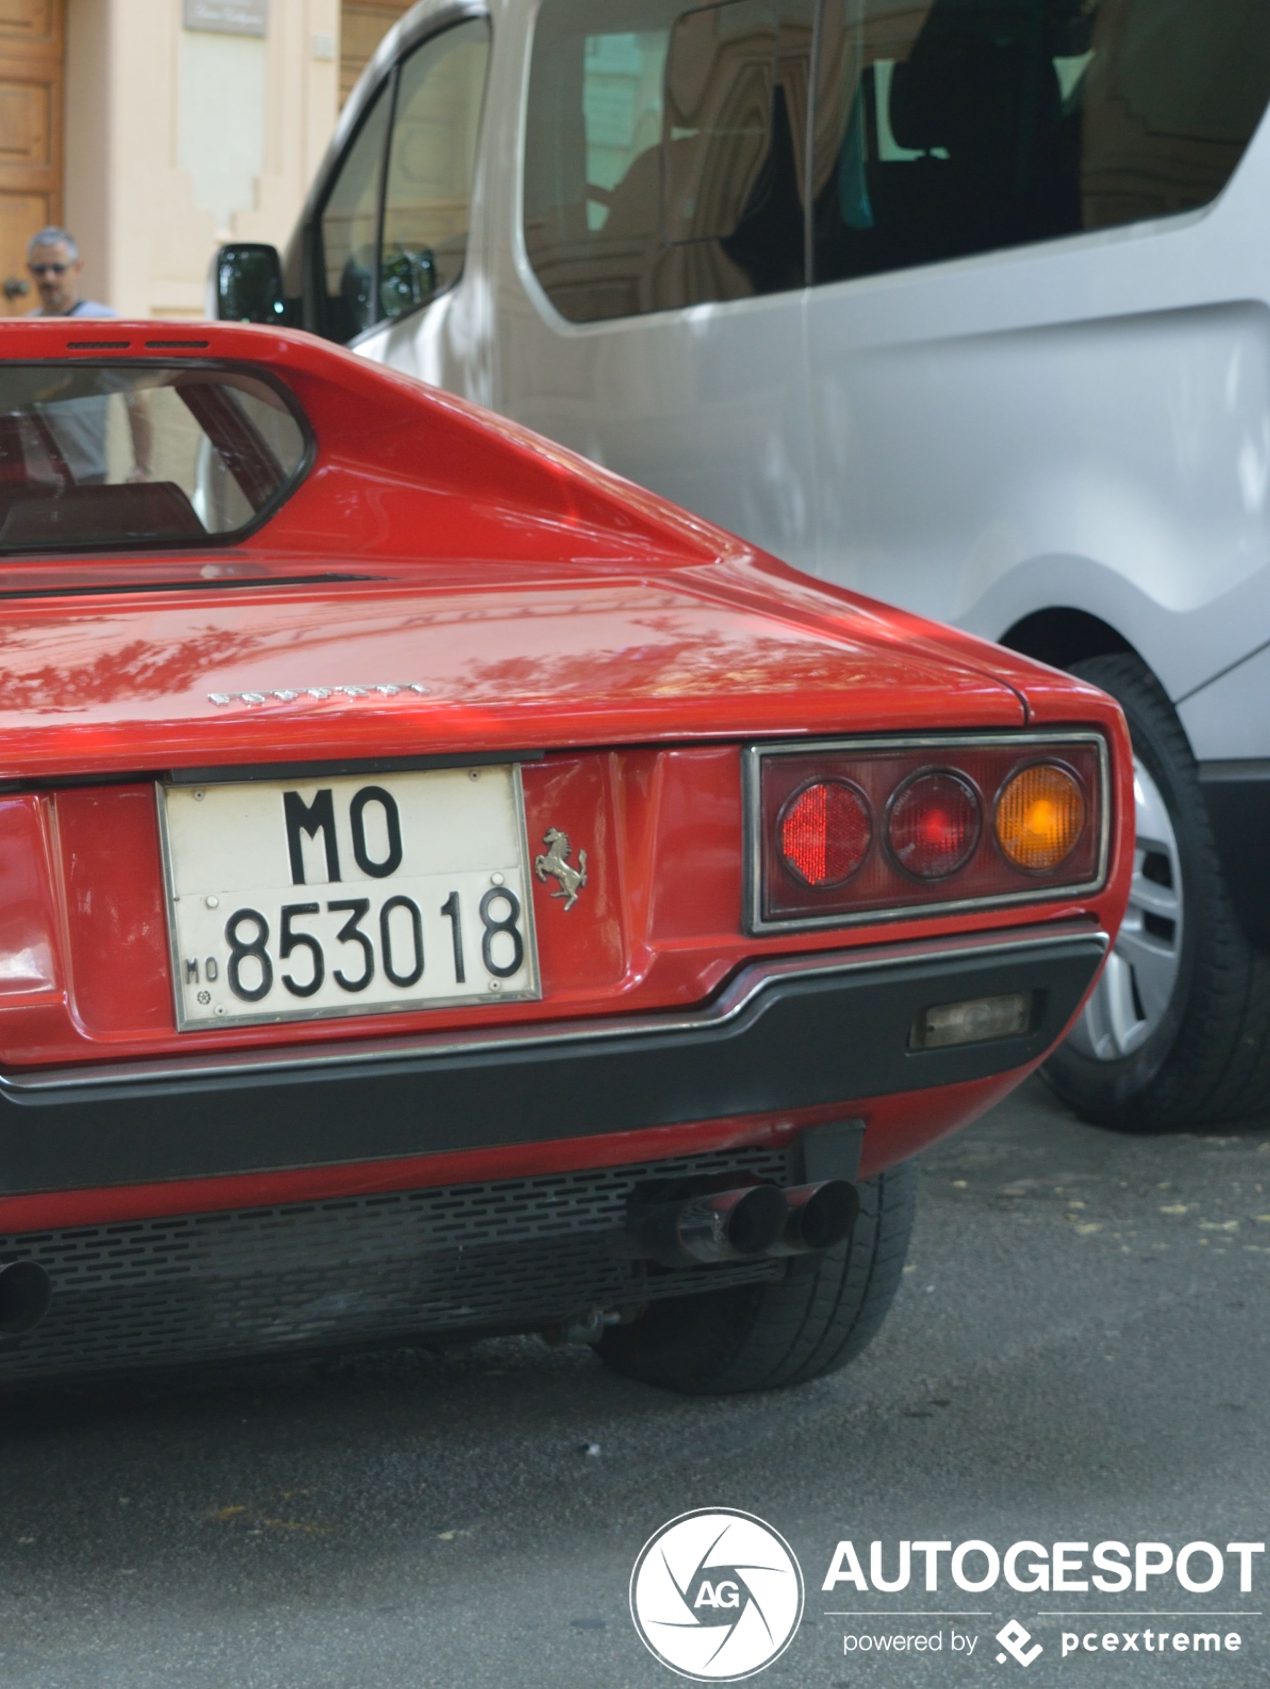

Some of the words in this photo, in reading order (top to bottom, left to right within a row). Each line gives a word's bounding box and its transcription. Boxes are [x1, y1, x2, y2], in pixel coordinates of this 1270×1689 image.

[283, 785, 403, 885] MO
[185, 956, 218, 984] MO
[224, 886, 524, 1002] 853018
